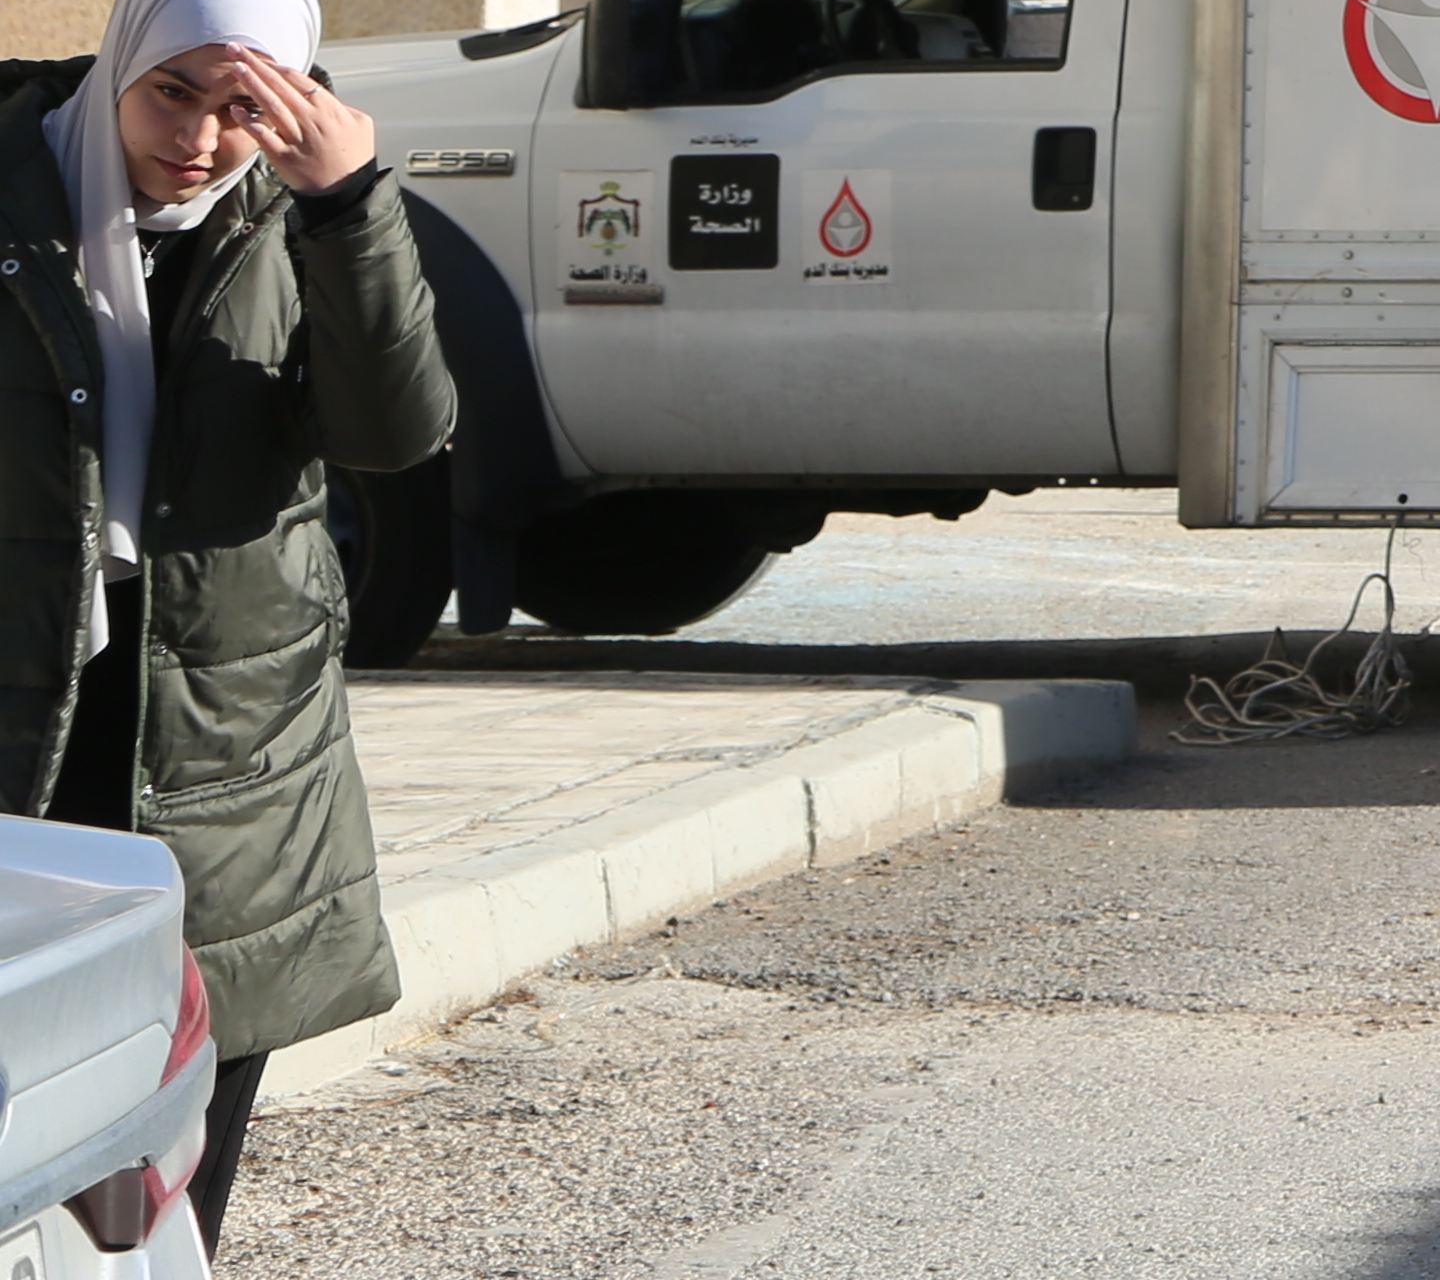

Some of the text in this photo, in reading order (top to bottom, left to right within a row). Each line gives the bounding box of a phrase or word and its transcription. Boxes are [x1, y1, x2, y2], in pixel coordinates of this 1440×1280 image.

[698, 183, 753, 205] وزارة
[688, 215, 761, 234] الصحة
[569, 263, 648, 285] وزارة الصحة
[852, 260, 889, 280] مديرية
